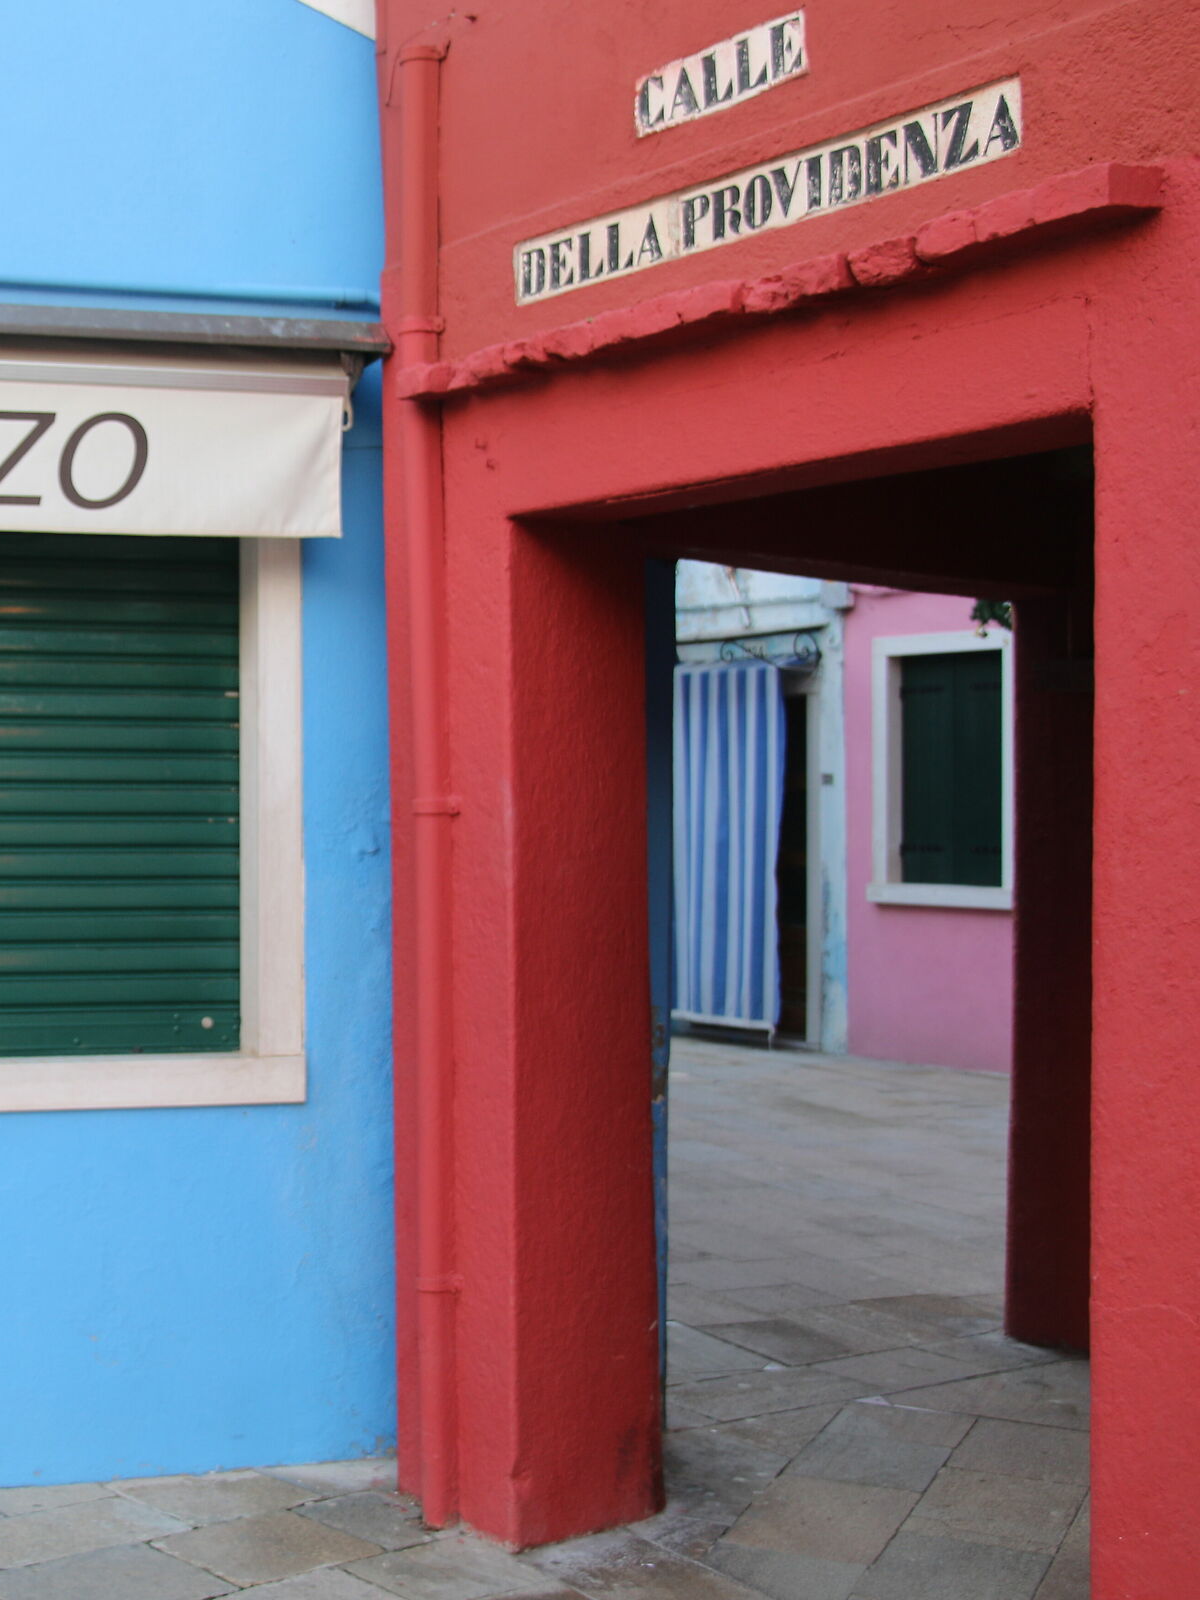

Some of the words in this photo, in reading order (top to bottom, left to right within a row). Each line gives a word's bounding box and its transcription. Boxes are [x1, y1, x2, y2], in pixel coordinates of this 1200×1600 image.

[639, 17, 802, 130] CALLE
[521, 214, 662, 297] DELLA
[681, 94, 1022, 251] PROVIDENZA
